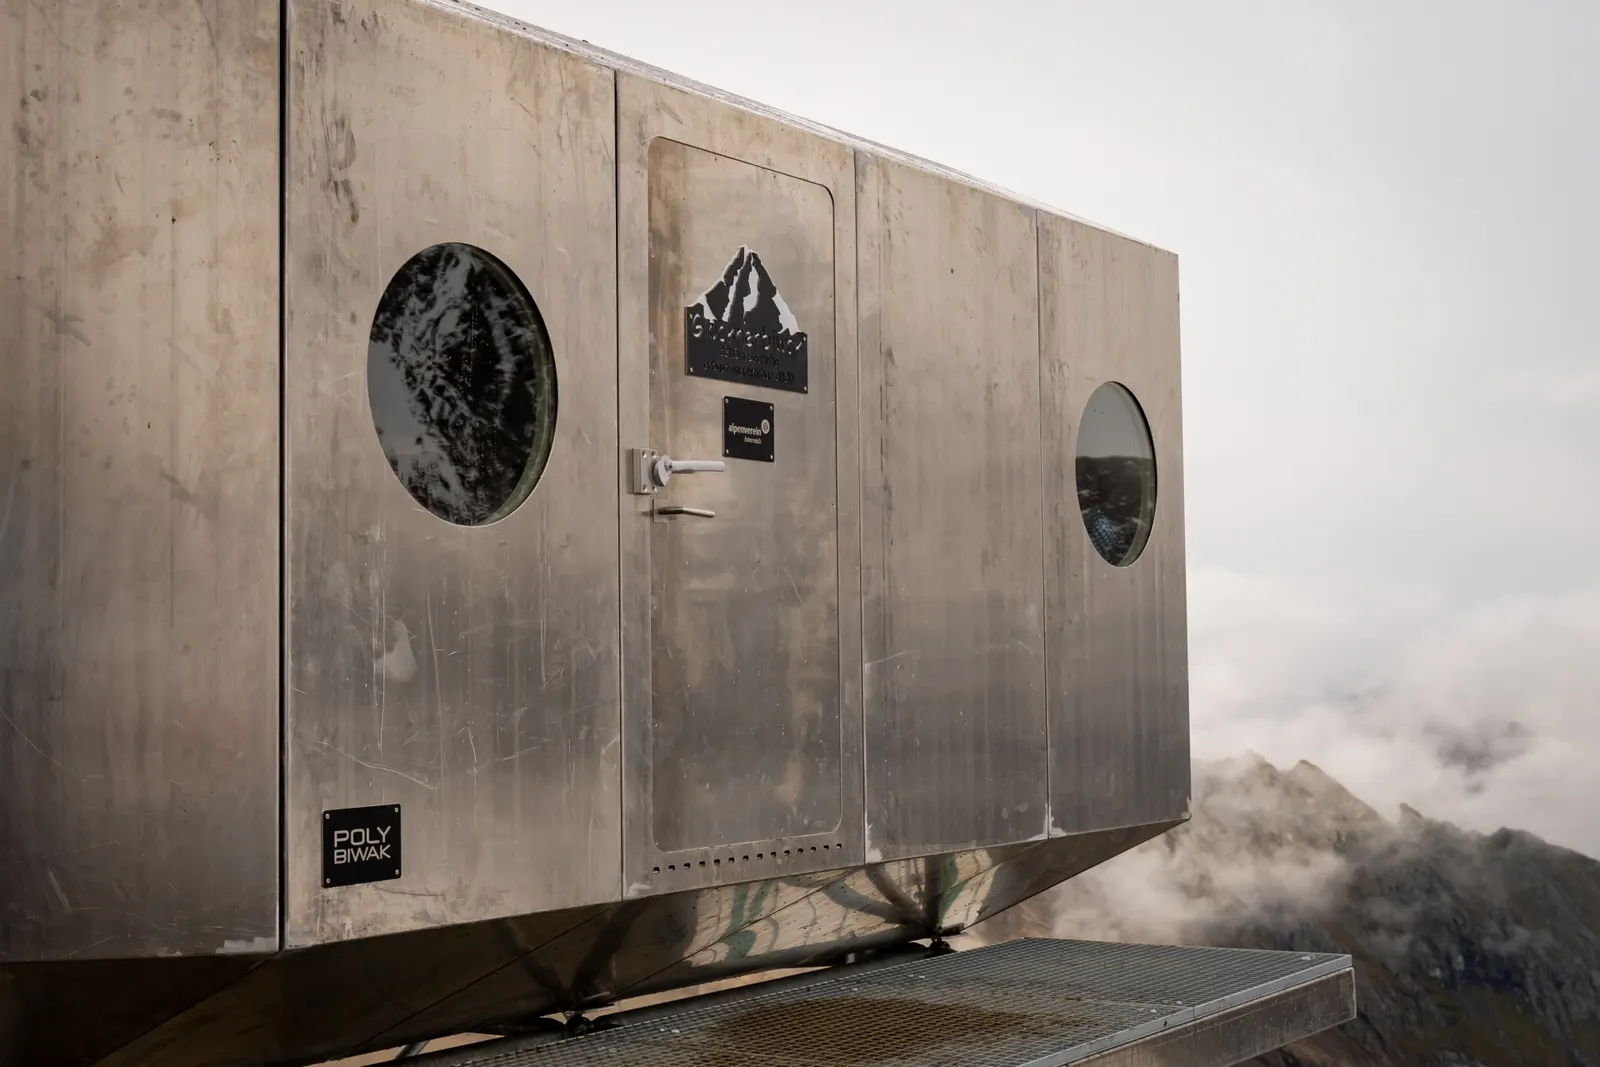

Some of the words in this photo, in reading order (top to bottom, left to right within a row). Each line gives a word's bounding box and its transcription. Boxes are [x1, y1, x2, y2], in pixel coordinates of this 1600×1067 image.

[728, 422, 762, 436] alpenverein
[334, 825, 391, 848] POLY
[334, 844, 391, 864] BIWAK
